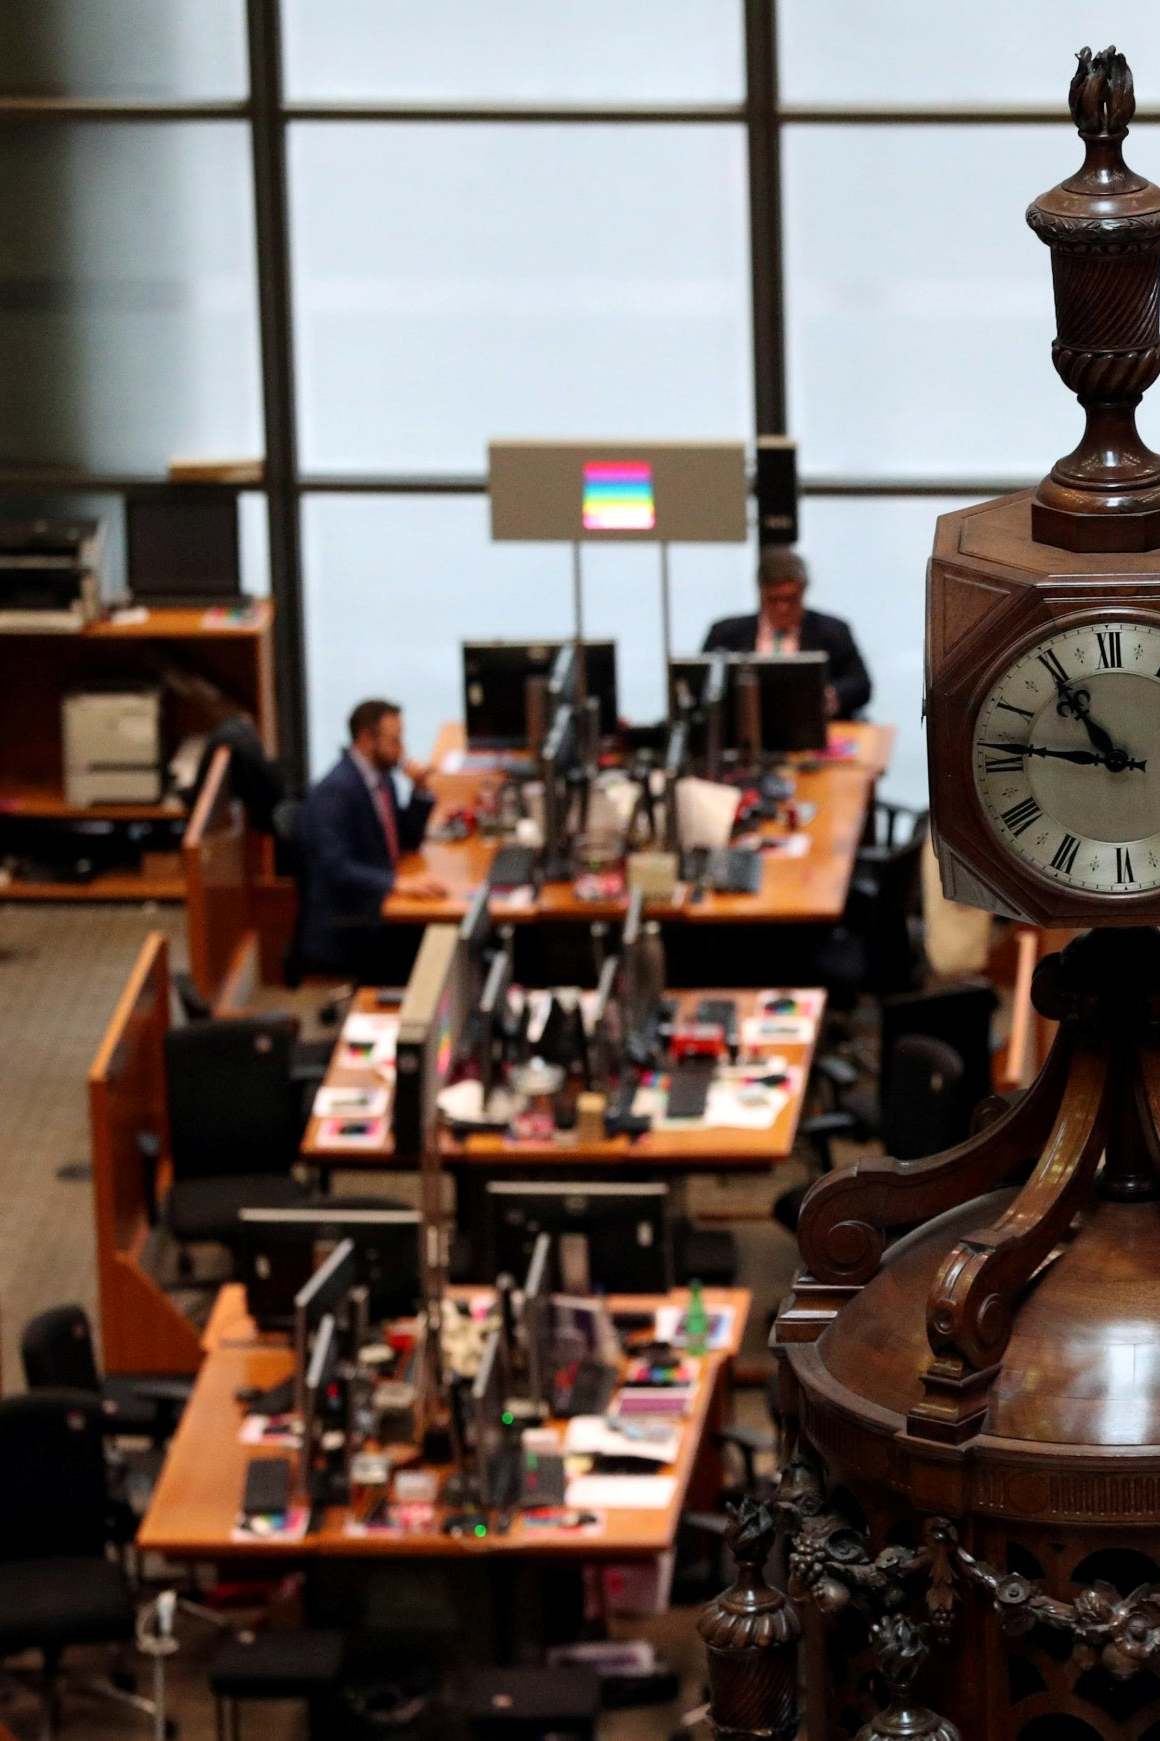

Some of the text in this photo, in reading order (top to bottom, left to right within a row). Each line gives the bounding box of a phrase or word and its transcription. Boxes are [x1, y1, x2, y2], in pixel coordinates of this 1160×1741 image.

[1037, 648, 1073, 689] XI
[1096, 631, 1124, 669] XII
[996, 697, 1036, 725] X
[985, 753, 1024, 773] IX
[1000, 796, 1044, 838] VIII
[1049, 833, 1082, 875] VII
[1114, 847, 1136, 884] VI
